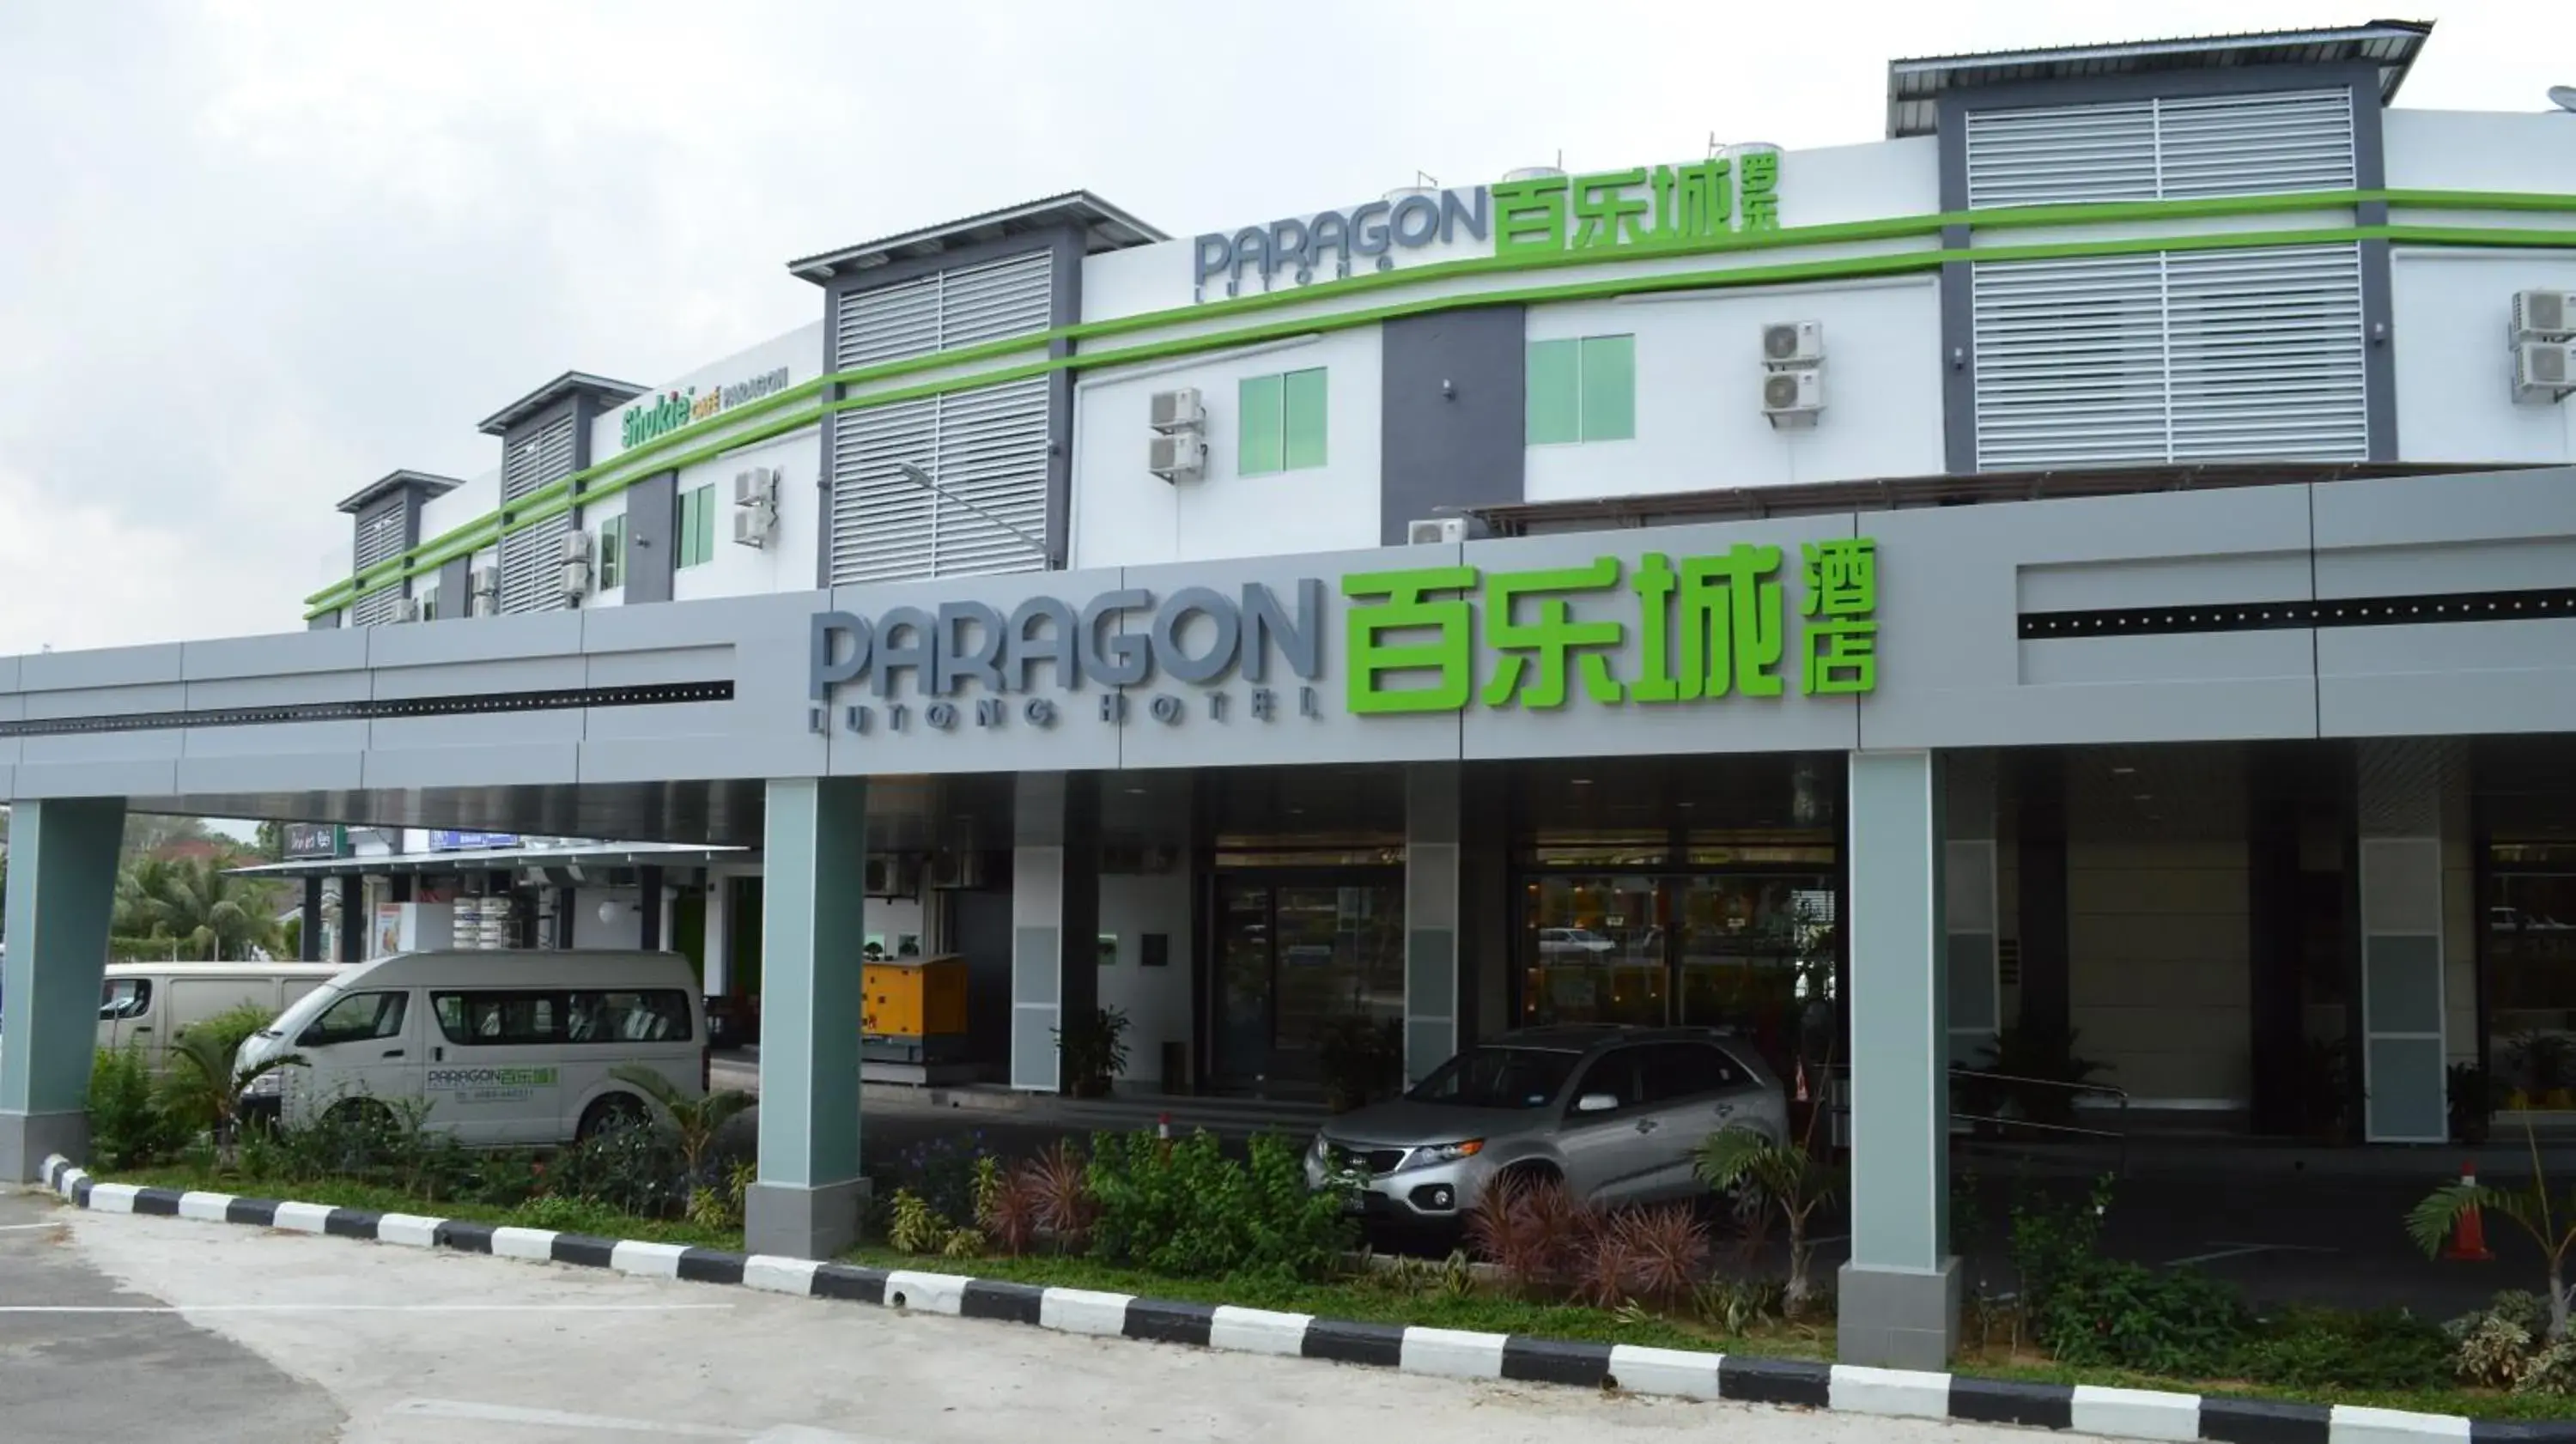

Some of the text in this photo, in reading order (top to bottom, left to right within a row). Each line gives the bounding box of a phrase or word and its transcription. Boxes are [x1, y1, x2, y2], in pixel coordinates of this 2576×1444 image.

[1194, 185, 1487, 287] PARAGON
[1492, 158, 1733, 252] 百乐城
[810, 578, 1324, 701] PARAGON
[1341, 543, 1784, 713] 百乐城
[1801, 537, 1879, 696] 酒店
[809, 687, 1321, 736] LUTONG HOTEL
[428, 1069, 500, 1083] PARAGON
